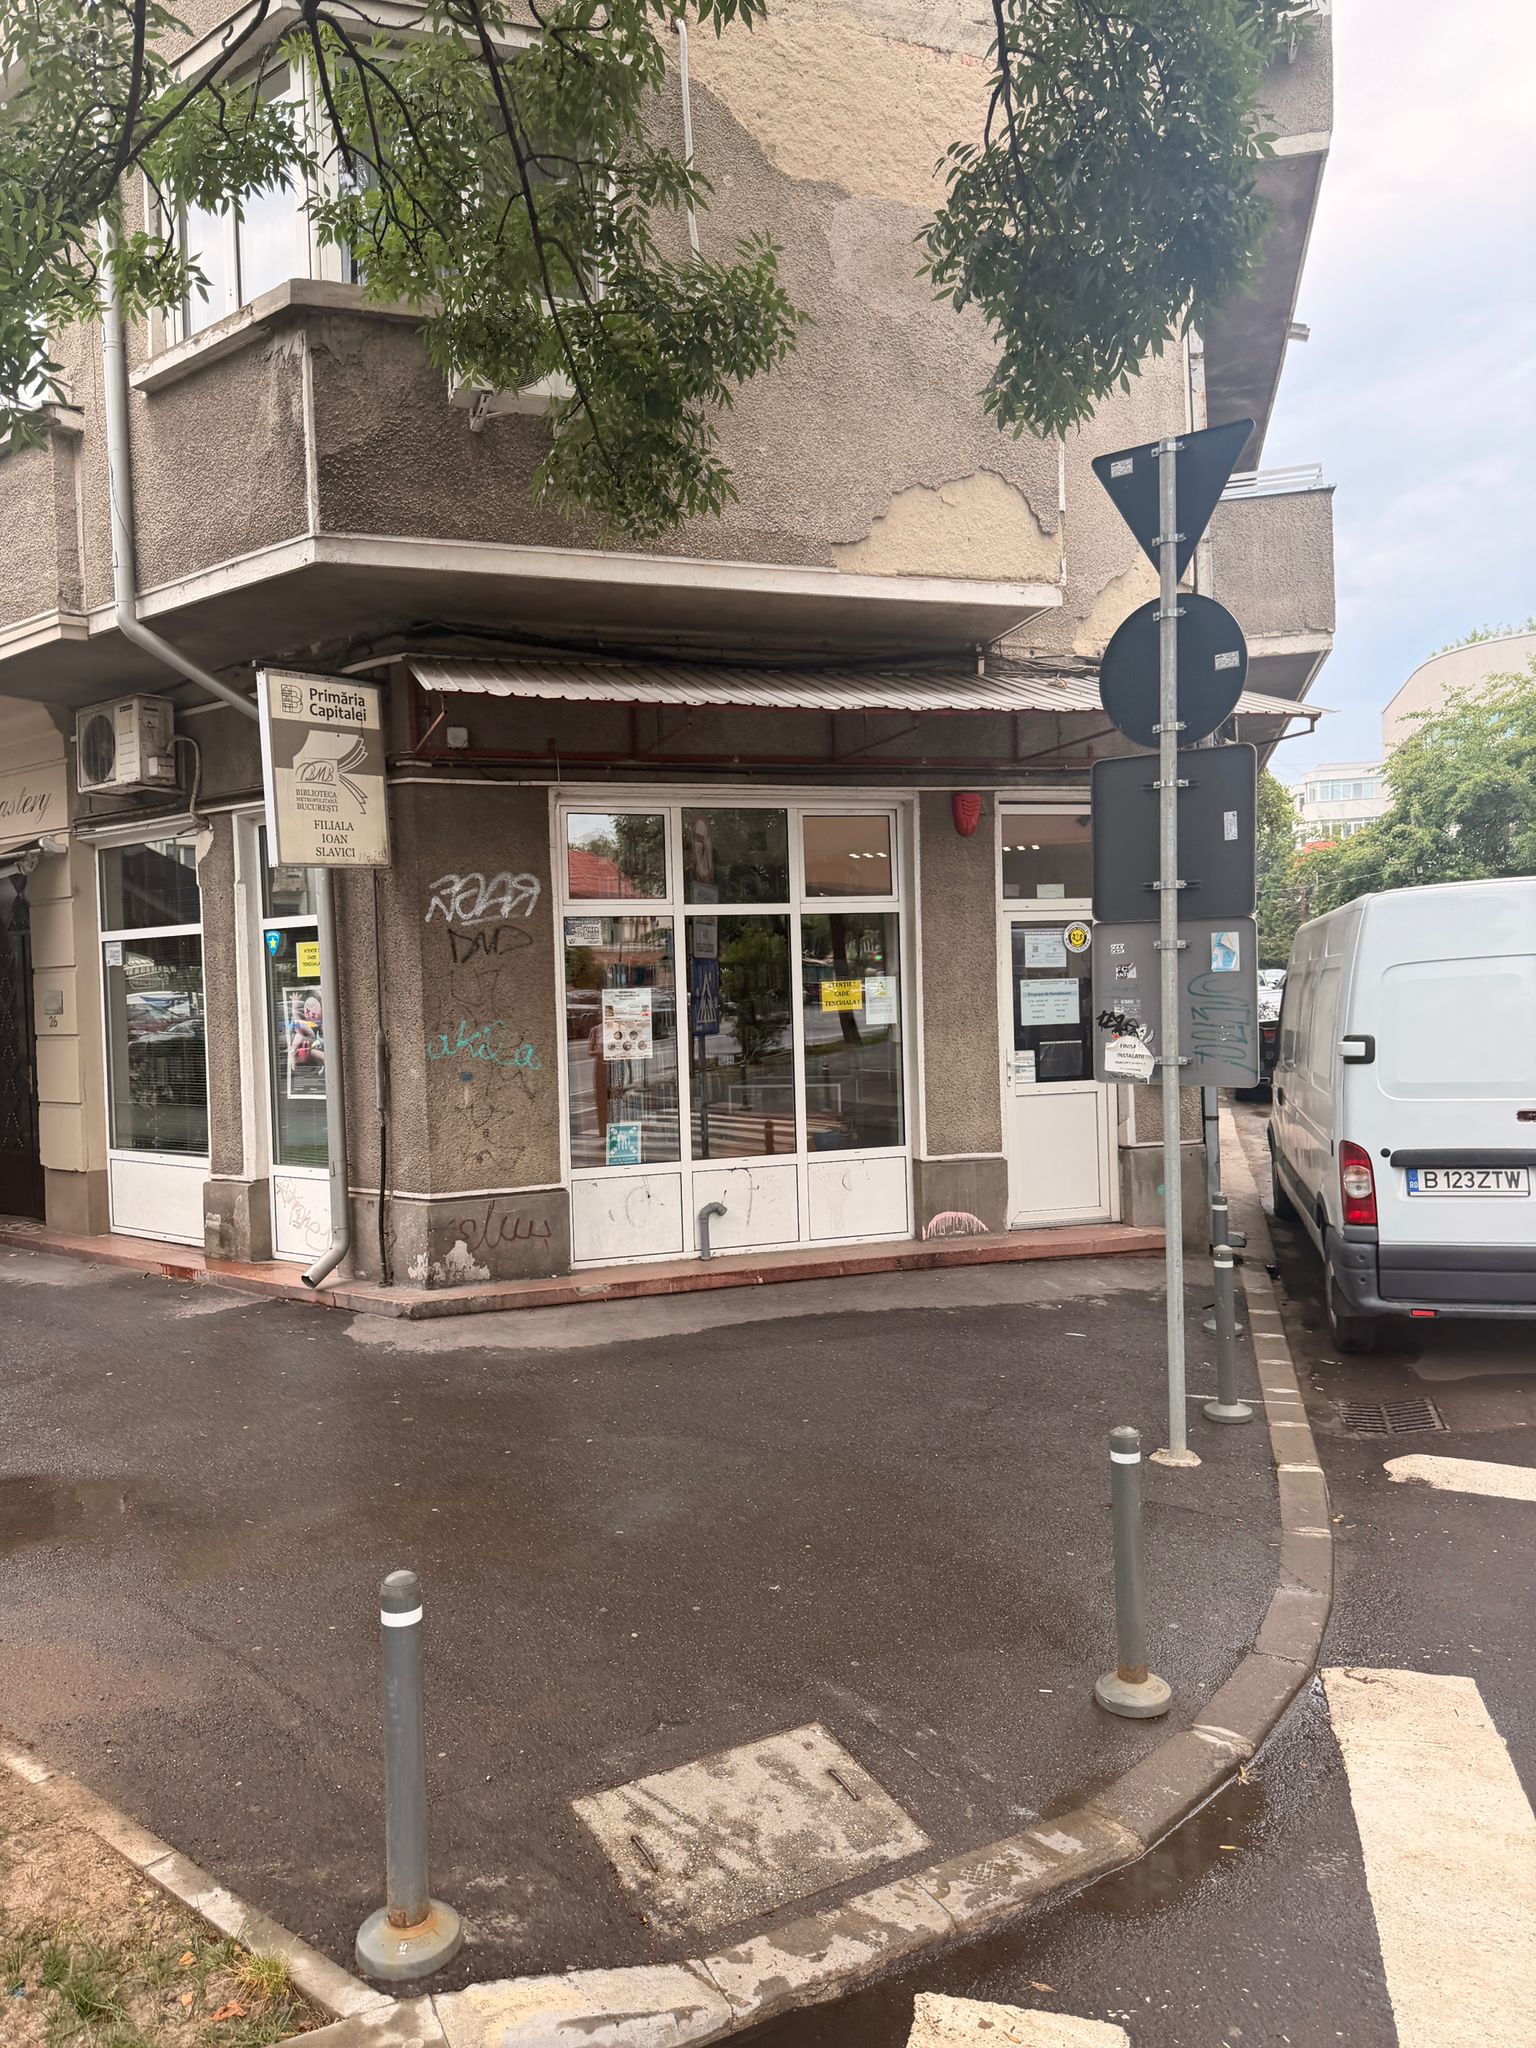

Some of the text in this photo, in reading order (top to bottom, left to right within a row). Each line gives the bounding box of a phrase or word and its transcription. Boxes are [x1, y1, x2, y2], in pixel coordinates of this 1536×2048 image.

[309, 687, 365, 707] Primăria
[309, 703, 367, 721] Capitalei
[295, 788, 338, 799] BIBLIOTECA
[314, 820, 355, 831] FILIALA
[322, 833, 348, 844] IOAN
[315, 846, 356, 858] SLAVICI
[48, 1015, 58, 1028] 26
[1409, 1181, 1418, 1189] RO
[1423, 1171, 1439, 1189] B
